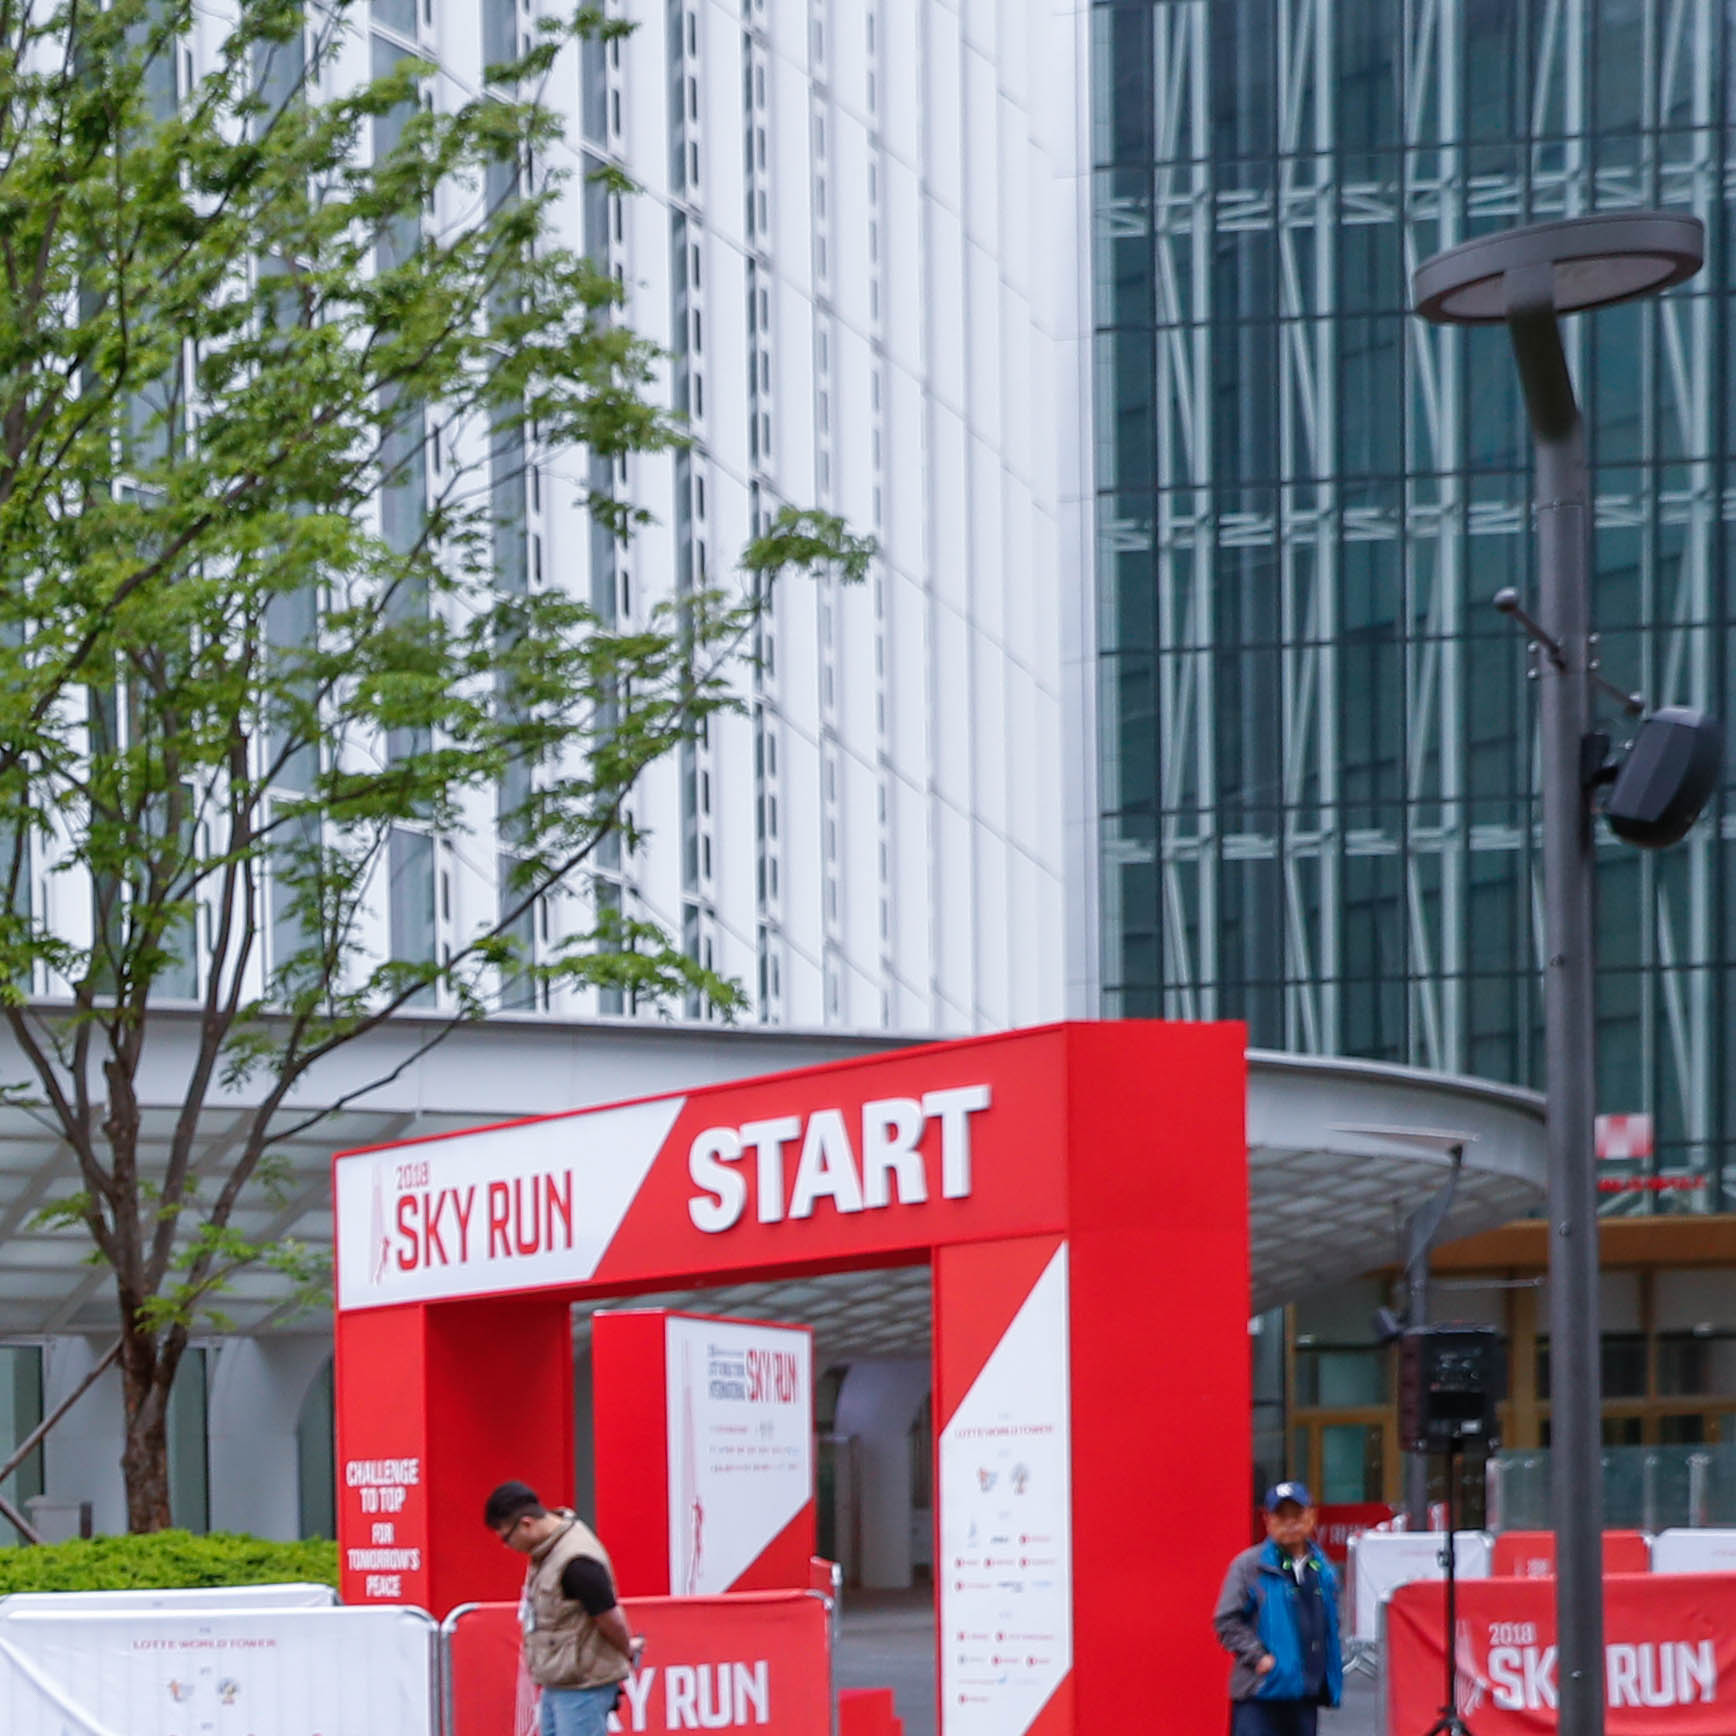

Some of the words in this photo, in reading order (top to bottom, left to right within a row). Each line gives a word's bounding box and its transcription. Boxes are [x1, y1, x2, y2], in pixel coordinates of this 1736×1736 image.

[396, 1161, 430, 1191] 2018
[688, 1084, 992, 1234] START
[396, 1184, 476, 1271] SKY
[487, 1169, 573, 1260] RUN
[746, 1348, 772, 1403] SKY
[774, 1351, 797, 1404] RUN
[345, 1458, 420, 1487] CHALLENGE
[360, 1487, 378, 1513] TO
[379, 1486, 406, 1513] TOP
[365, 1575, 402, 1598] PEACE
[1489, 1622, 1536, 1645] 2018
[664, 1660, 770, 1730] RUN
[1488, 1646, 1560, 1711] SK
[1605, 1640, 1718, 1709] RUN
